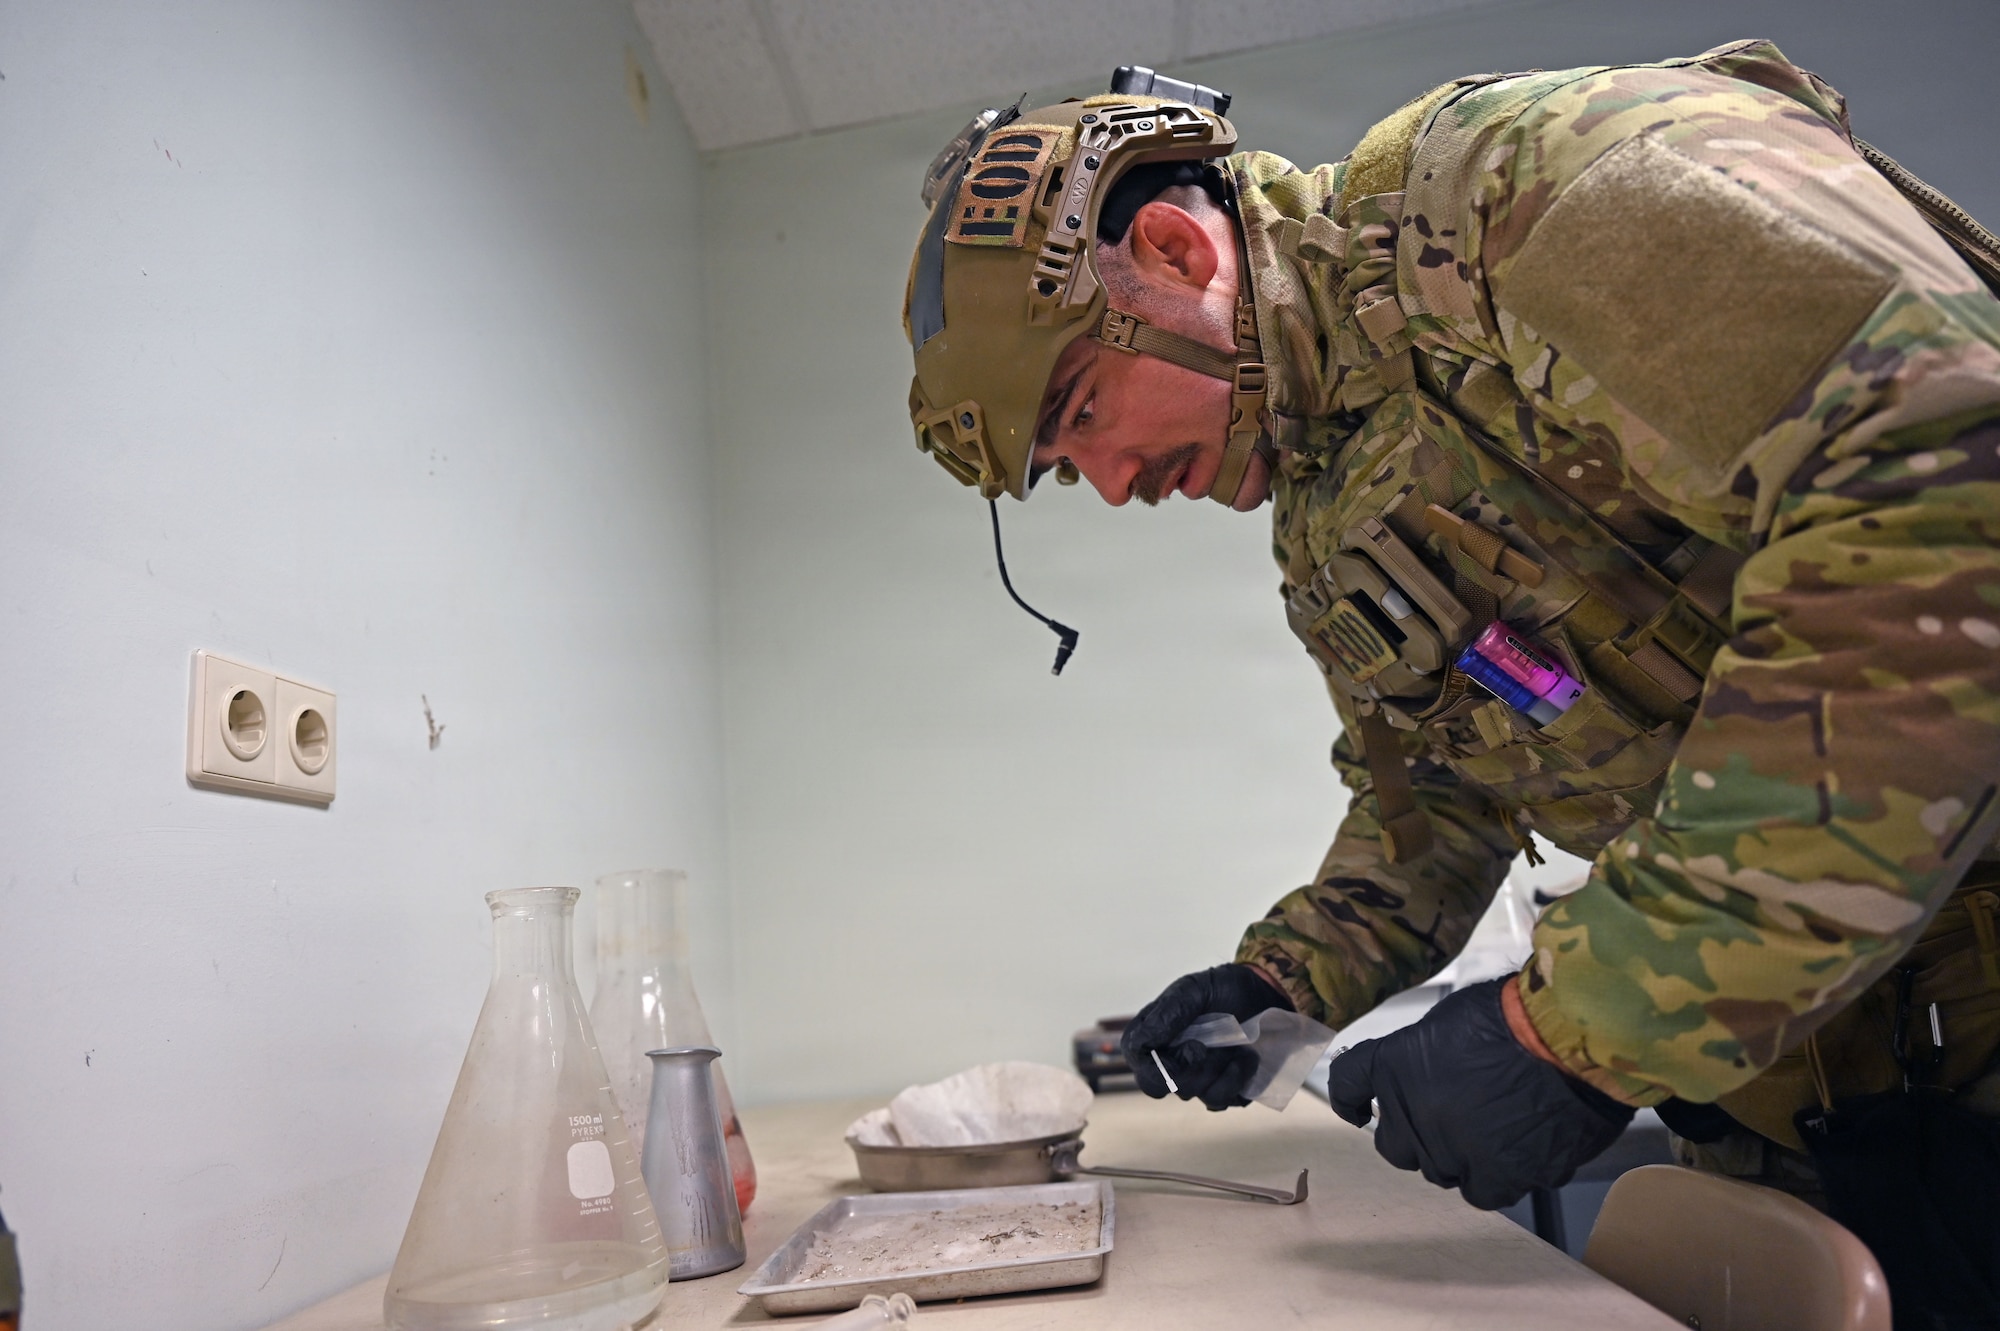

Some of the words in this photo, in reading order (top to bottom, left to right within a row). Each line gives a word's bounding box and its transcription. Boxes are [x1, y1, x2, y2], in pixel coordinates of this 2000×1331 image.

[958, 134, 1044, 236] EOD
[1315, 609, 1386, 674] EOD
[568, 1115, 592, 1126] 1500
[593, 1113, 602, 1124] ml
[594, 1198, 611, 1206] 4980
